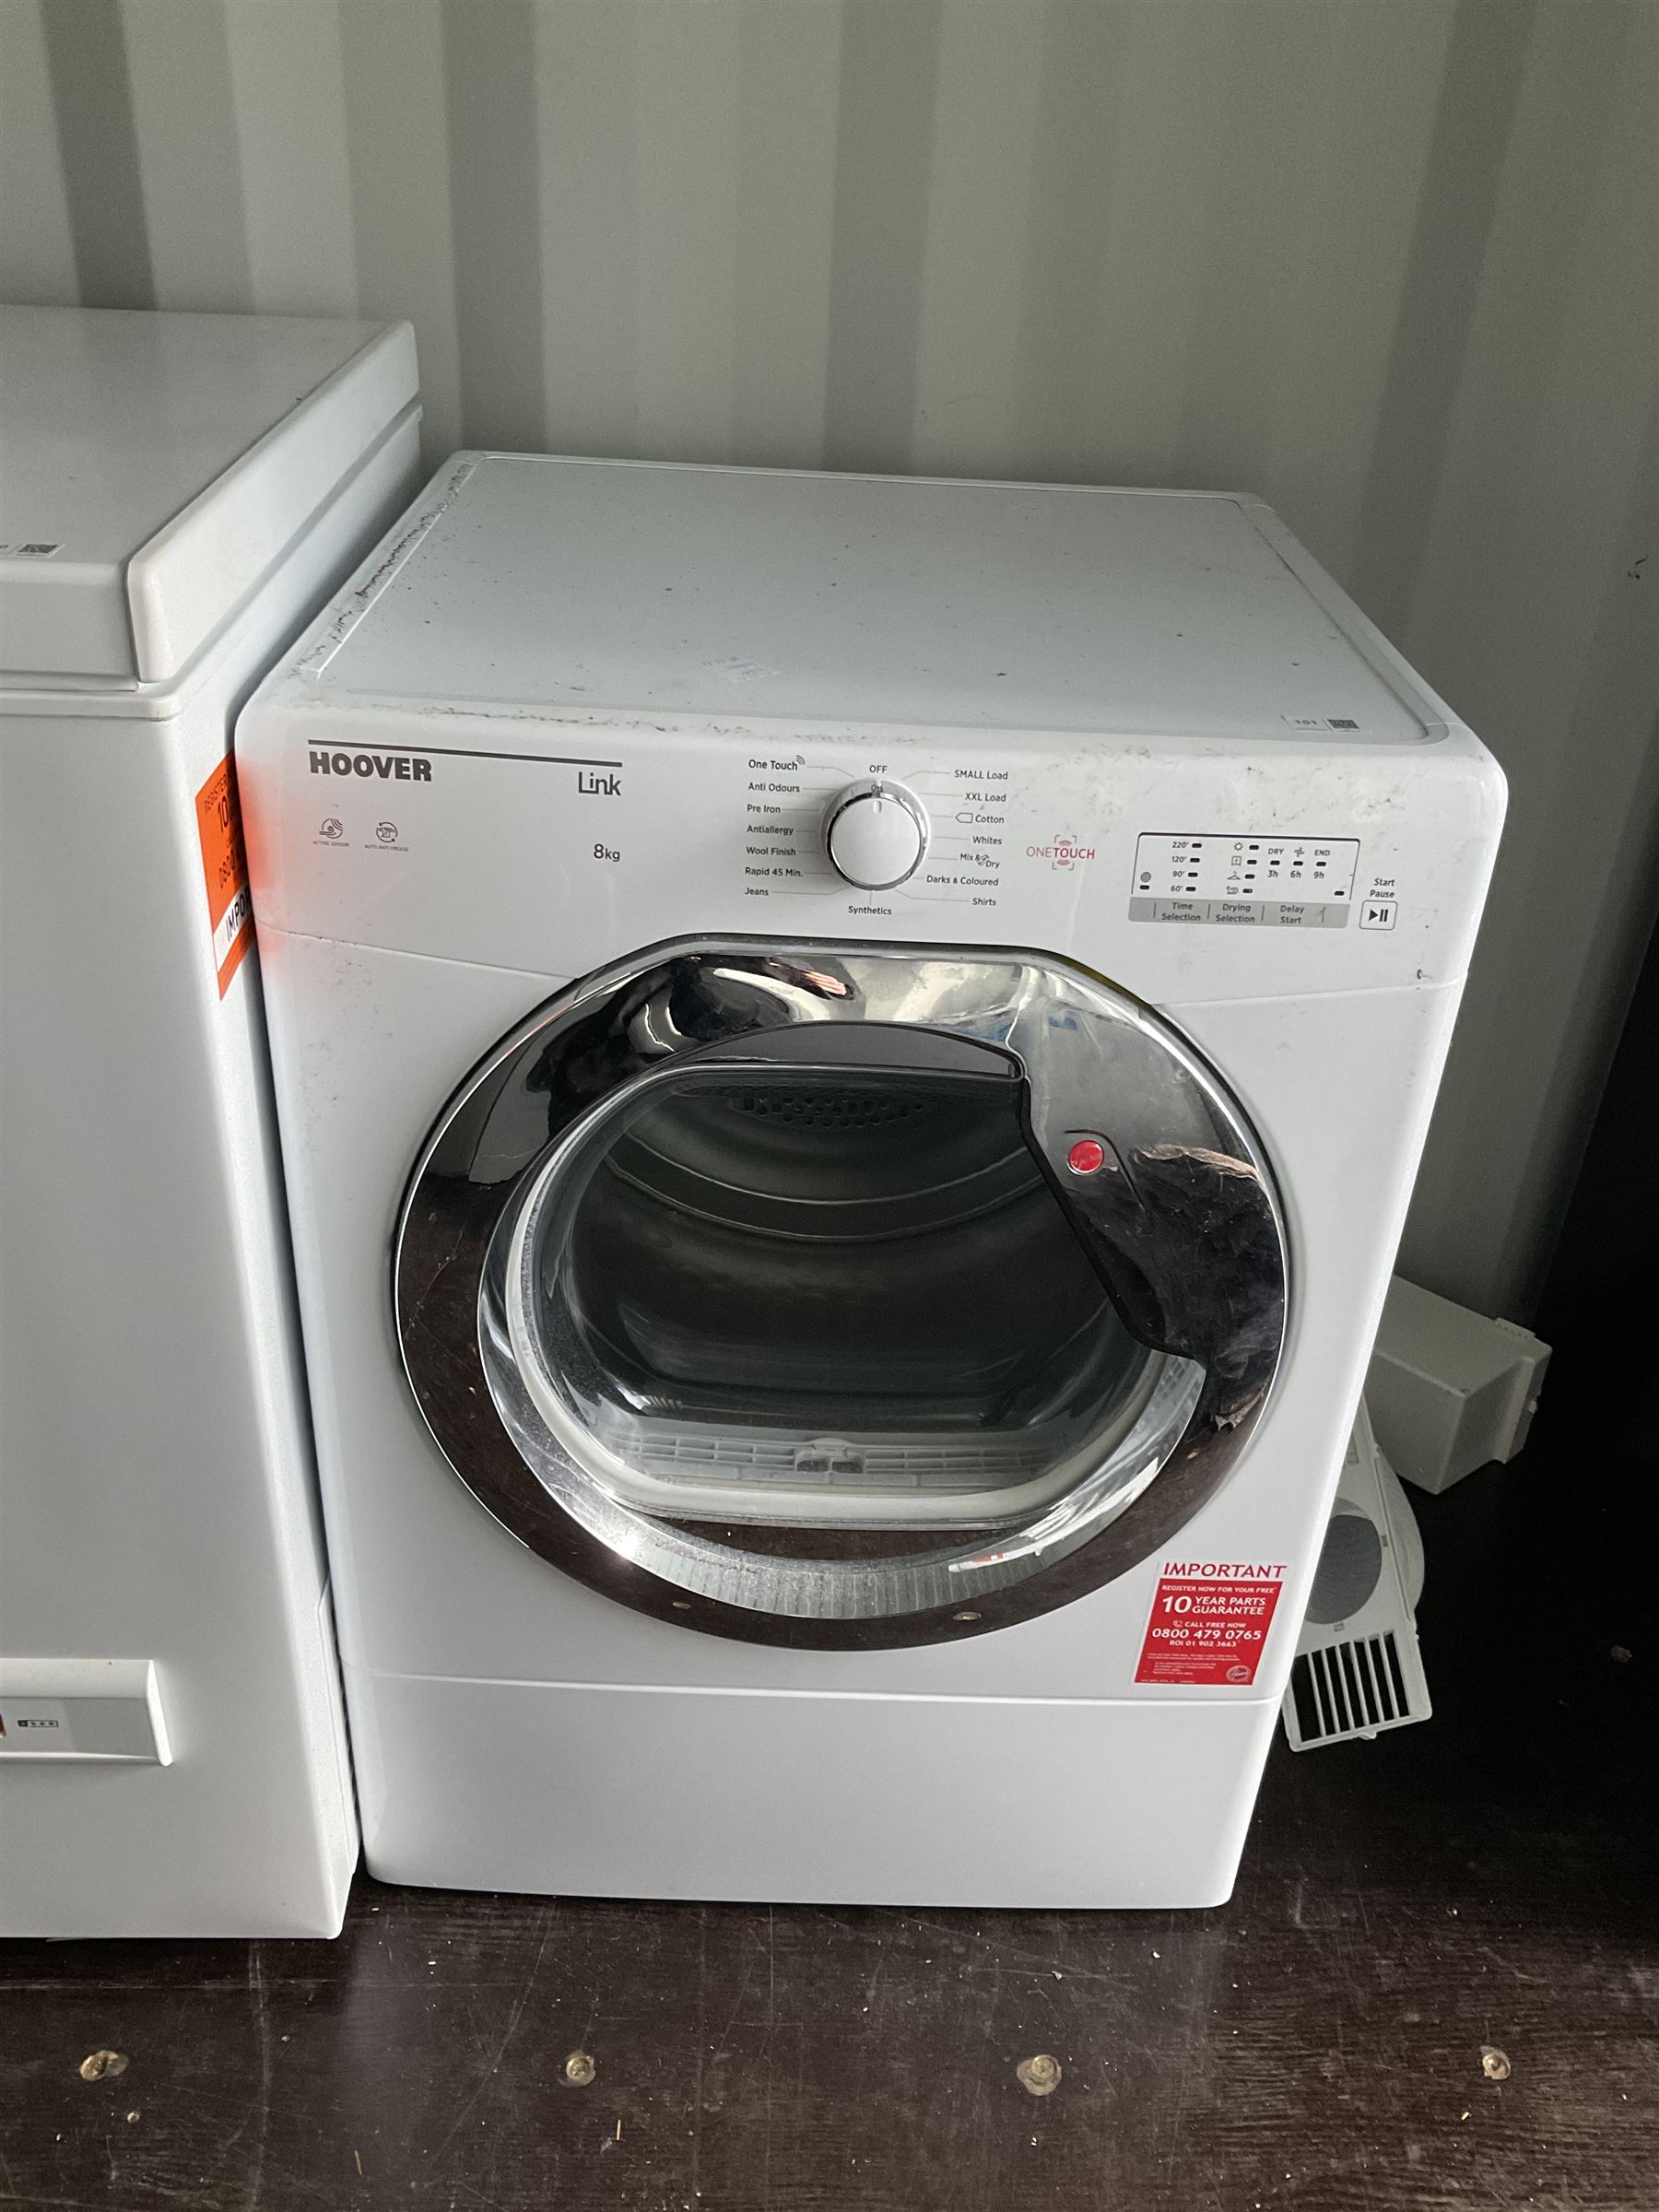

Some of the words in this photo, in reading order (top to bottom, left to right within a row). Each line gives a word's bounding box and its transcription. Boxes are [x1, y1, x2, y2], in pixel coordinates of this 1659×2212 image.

[308, 750, 433, 782] HOOVER
[748, 759, 768, 771] One
[771, 759, 798, 771] Touch
[869, 764, 888, 774] OFF
[954, 769, 984, 780] SMALL
[986, 771, 1009, 781] Load
[577, 771, 623, 796] Link
[748, 782, 766, 792] Anti
[769, 782, 800, 793] Odours
[965, 792, 982, 801] XXL
[984, 793, 1006, 803] Load
[747, 804, 761, 813] Pre
[763, 805, 781, 814] Iron
[217, 795, 229, 834] 10
[975, 815, 1005, 825] Cotton
[747, 825, 794, 836] Antiallergy
[972, 835, 1003, 845] Whites
[593, 842, 621, 863] 8kg
[746, 846, 769, 855] Wool
[771, 847, 796, 856] Finish
[959, 853, 973, 861] Mix
[974, 853, 981, 862] &
[985, 860, 1000, 869] Dry
[745, 866, 770, 877] Rapid
[771, 868, 783, 877] 45
[785, 868, 804, 877] Min.
[1267, 869, 1278, 878] 3h
[1289, 870, 1301, 878] 6h
[1313, 871, 1324, 879] 9h
[926, 875, 950, 885] Darks
[952, 877, 959, 885] &
[959, 877, 999, 887] Coloured
[1373, 877, 1395, 888] Start
[744, 887, 769, 896] Jeans
[1370, 889, 1395, 899] Pause
[972, 898, 996, 907] Shirts
[1171, 901, 1194, 911] Time
[848, 905, 892, 916] Synthetics
[1222, 903, 1252, 913] Drying
[1280, 904, 1305, 915] Delay
[1161, 912, 1201, 922] Selection
[1215, 914, 1255, 924] Selection
[1280, 915, 1301, 924] Start
[1163, 1562, 1288, 1579] IMPORTANT
[1162, 1595, 1192, 1614] 10
[1194, 1596, 1227, 1606] YEAR
[1229, 1596, 1266, 1606] PARTS
[1192, 1606, 1265, 1616] GUARANTEE
[1151, 1628, 1189, 1639] 0800
[1193, 1630, 1220, 1640] 479
[1225, 1630, 1262, 1641] 0765
